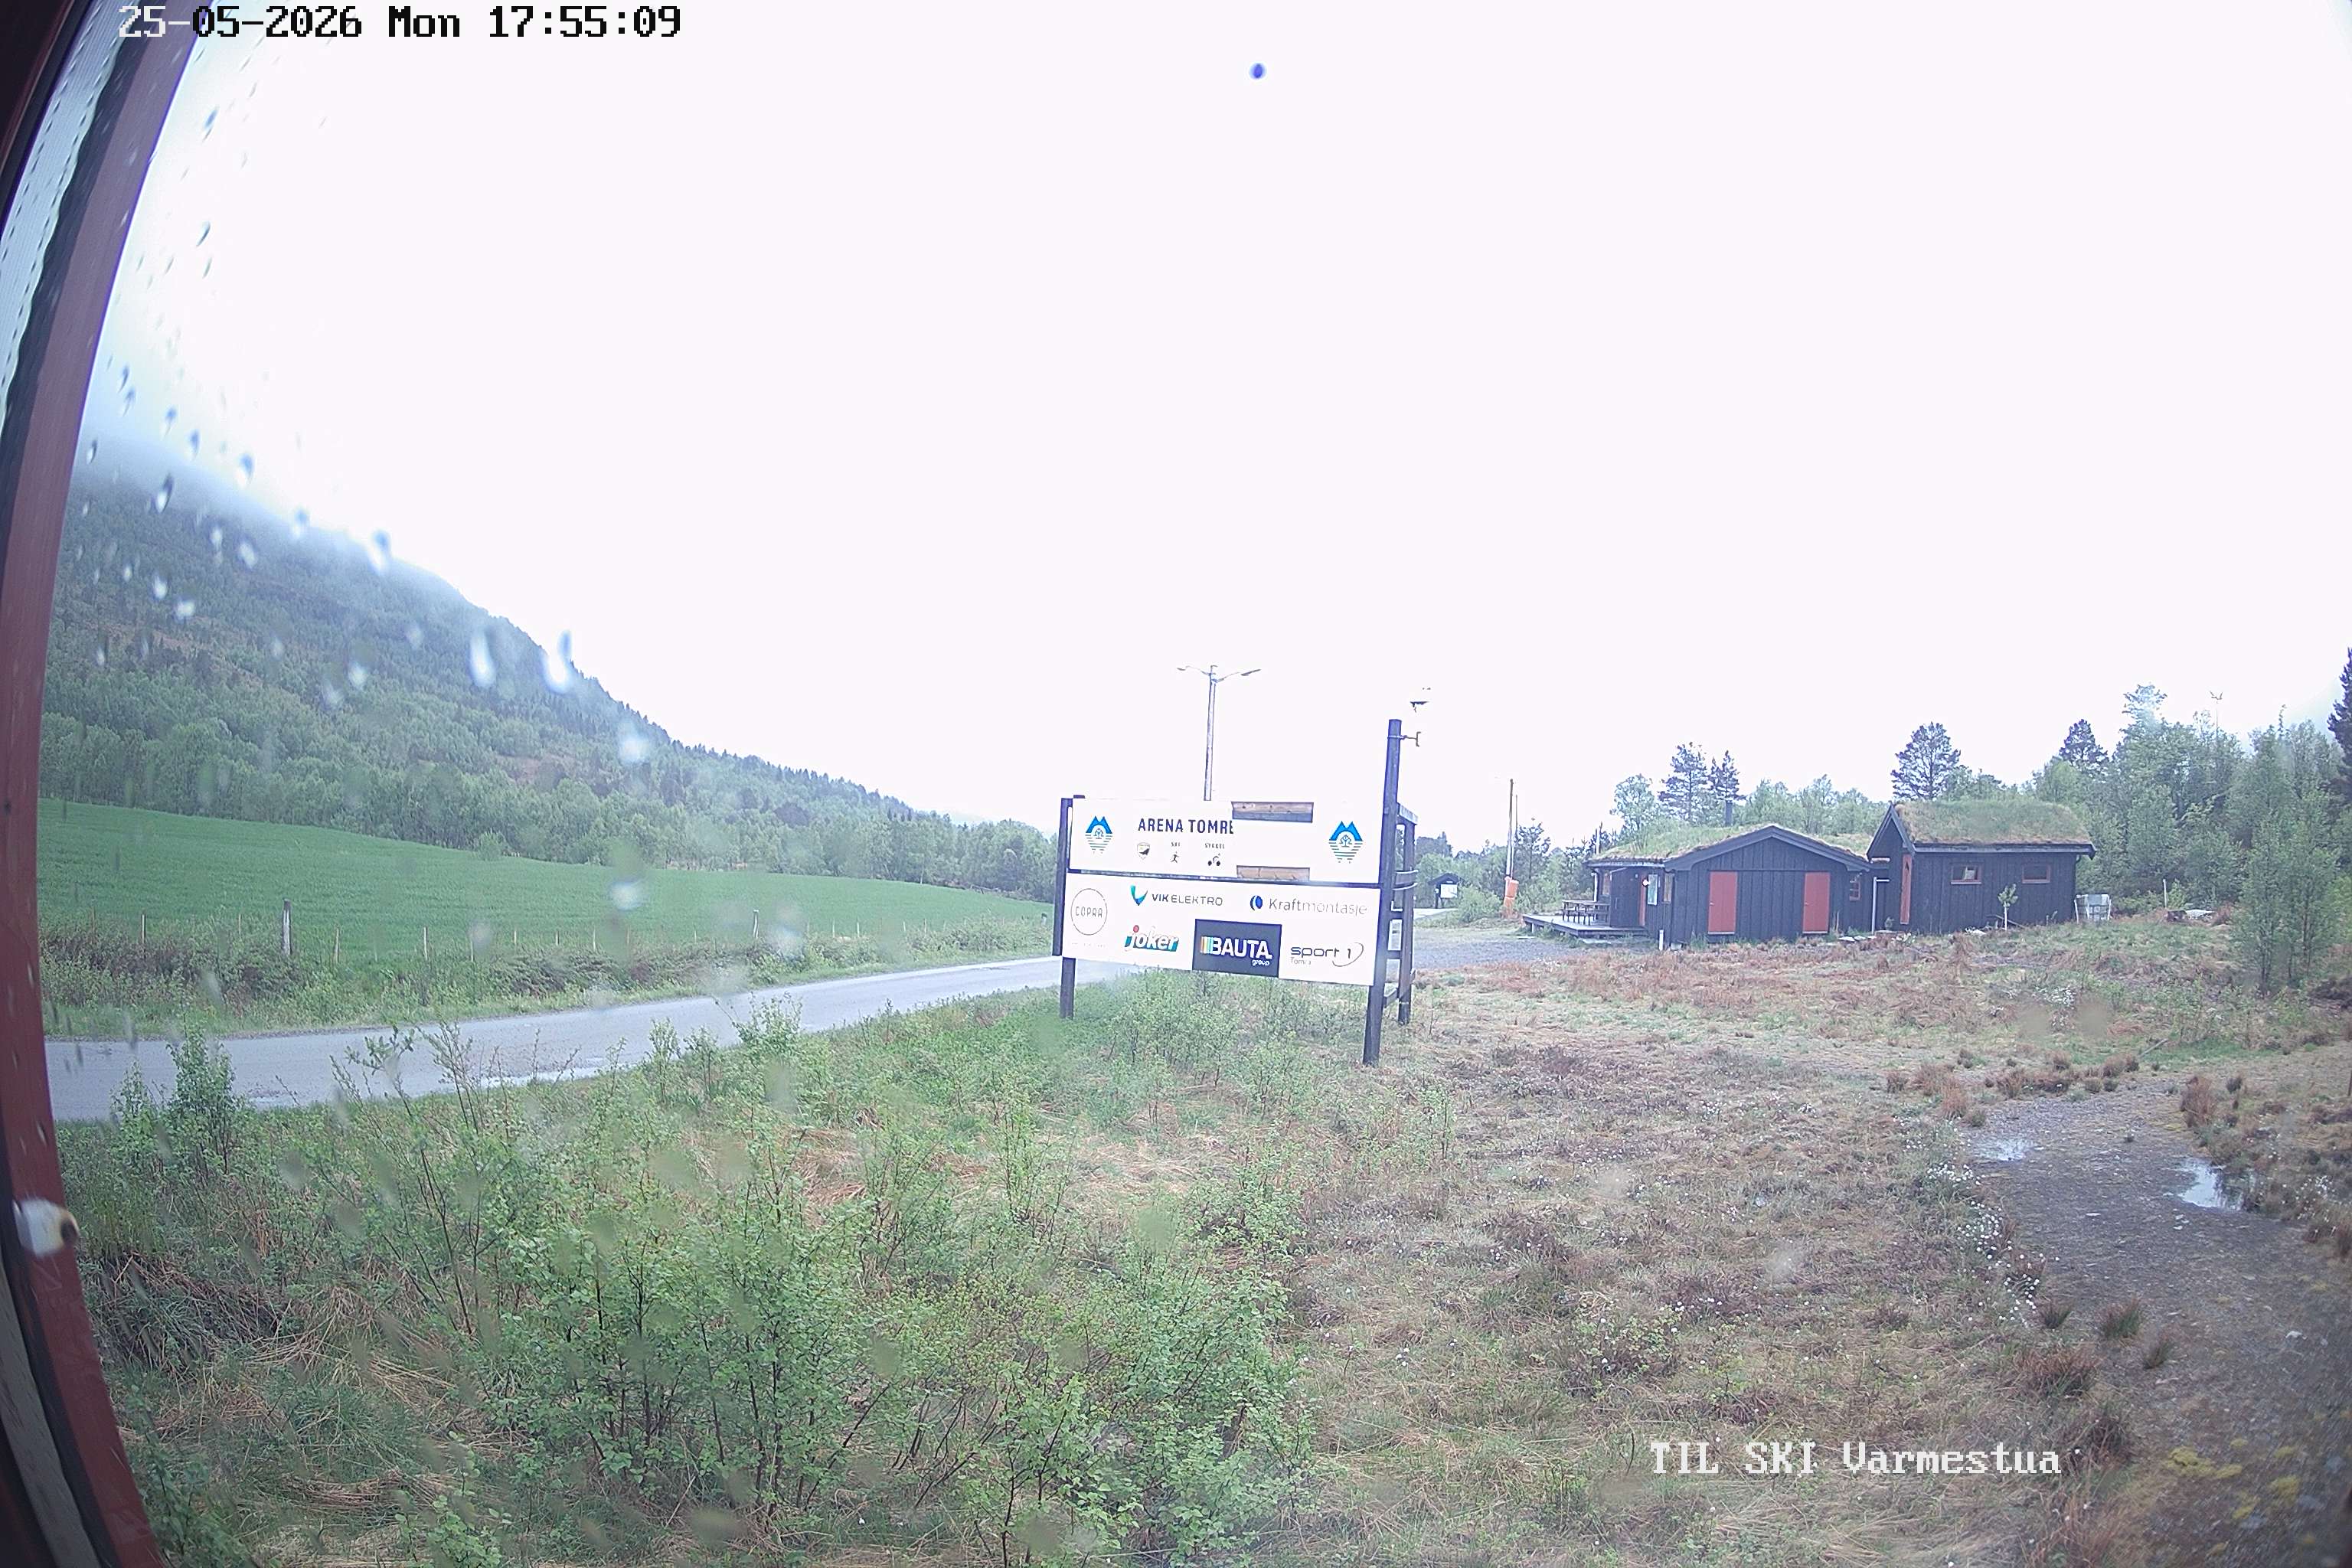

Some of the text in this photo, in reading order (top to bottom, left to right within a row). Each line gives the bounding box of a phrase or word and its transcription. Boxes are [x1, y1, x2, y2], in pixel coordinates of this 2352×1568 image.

[1138, 818, 1184, 833] ARENA
[1152, 893, 1223, 906] VIK ELEKTRO
[1269, 898, 1367, 916] Kraftmontasje
[1075, 906, 1103, 919] COPRA
[1124, 924, 1179, 952] joker
[1209, 937, 1273, 960] BAUTA
[1290, 946, 1340, 959] sport
